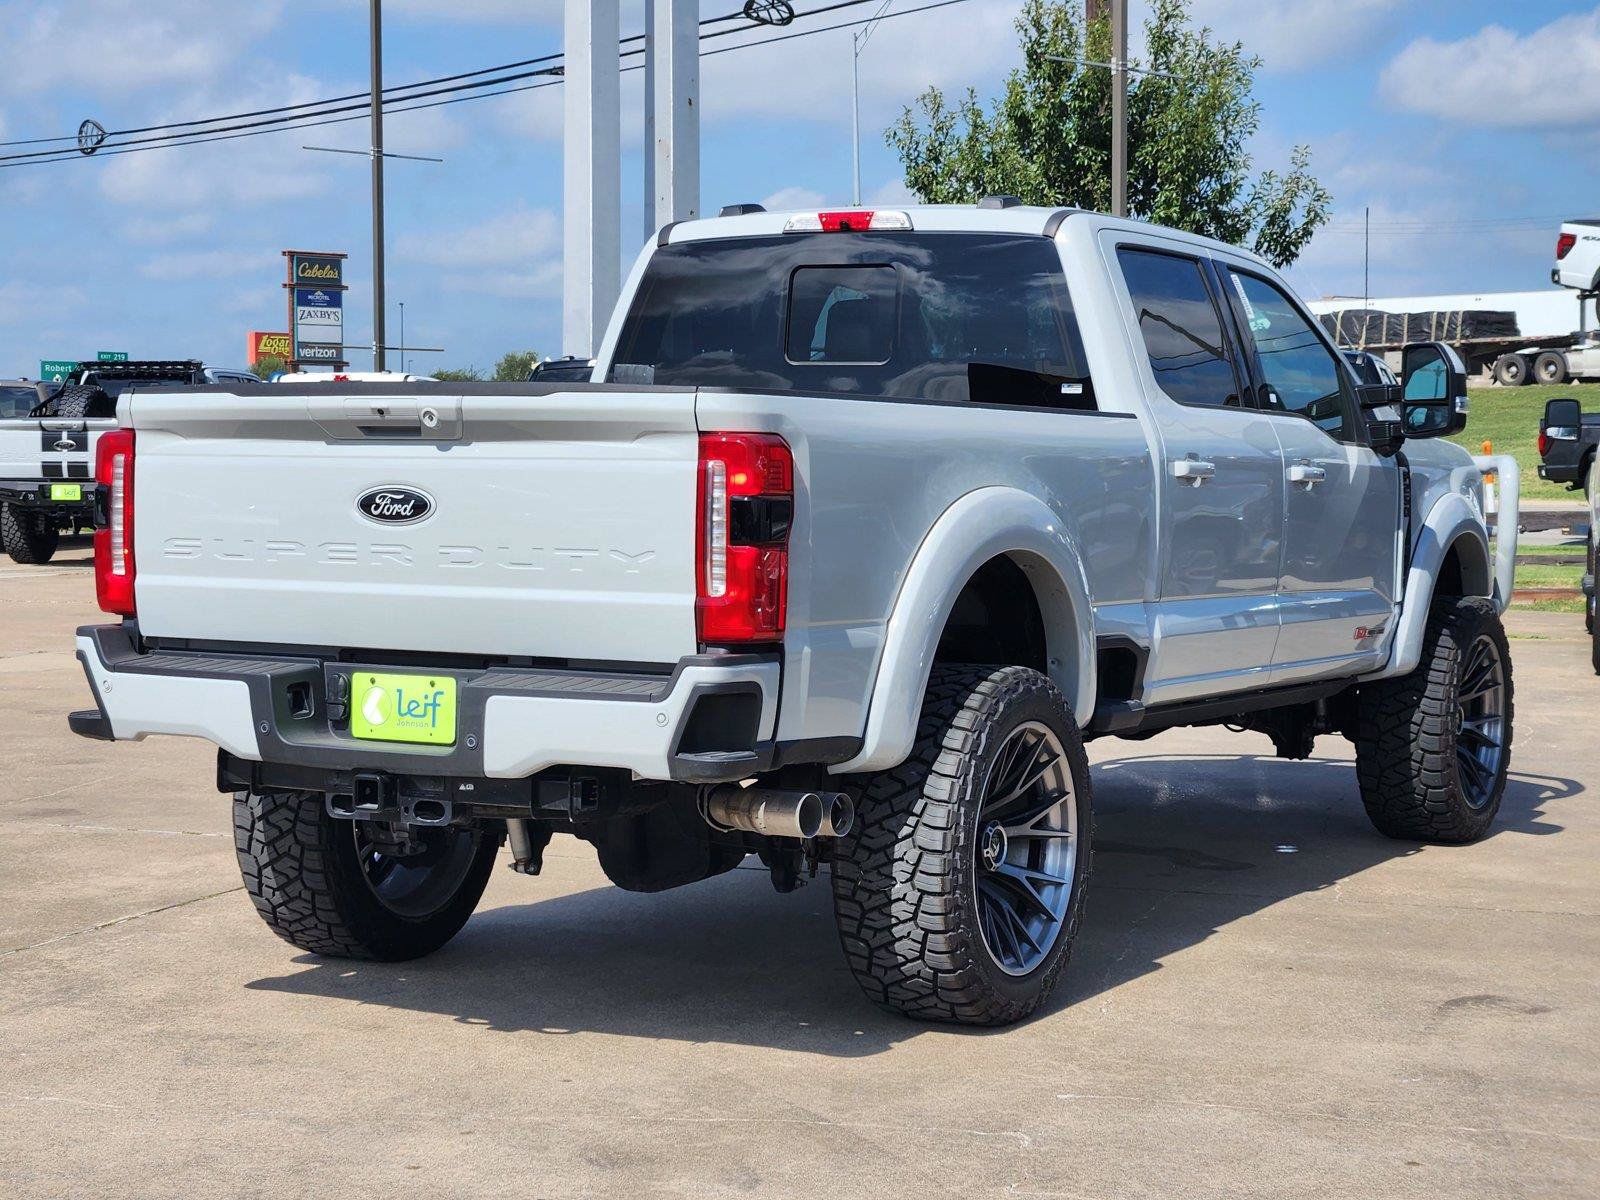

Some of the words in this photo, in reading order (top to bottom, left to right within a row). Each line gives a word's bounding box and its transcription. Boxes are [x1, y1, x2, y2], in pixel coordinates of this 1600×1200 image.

[298, 262, 339, 279] Cabela's
[299, 309, 340, 321] ZAXBY'S
[299, 346, 336, 358] verizon
[45, 364, 72, 372] Robert
[371, 493, 416, 516] Ford
[164, 537, 414, 567] SUPER
[438, 545, 656, 573] DUTY
[396, 688, 444, 728] leif
[396, 719, 429, 728] Johnson
